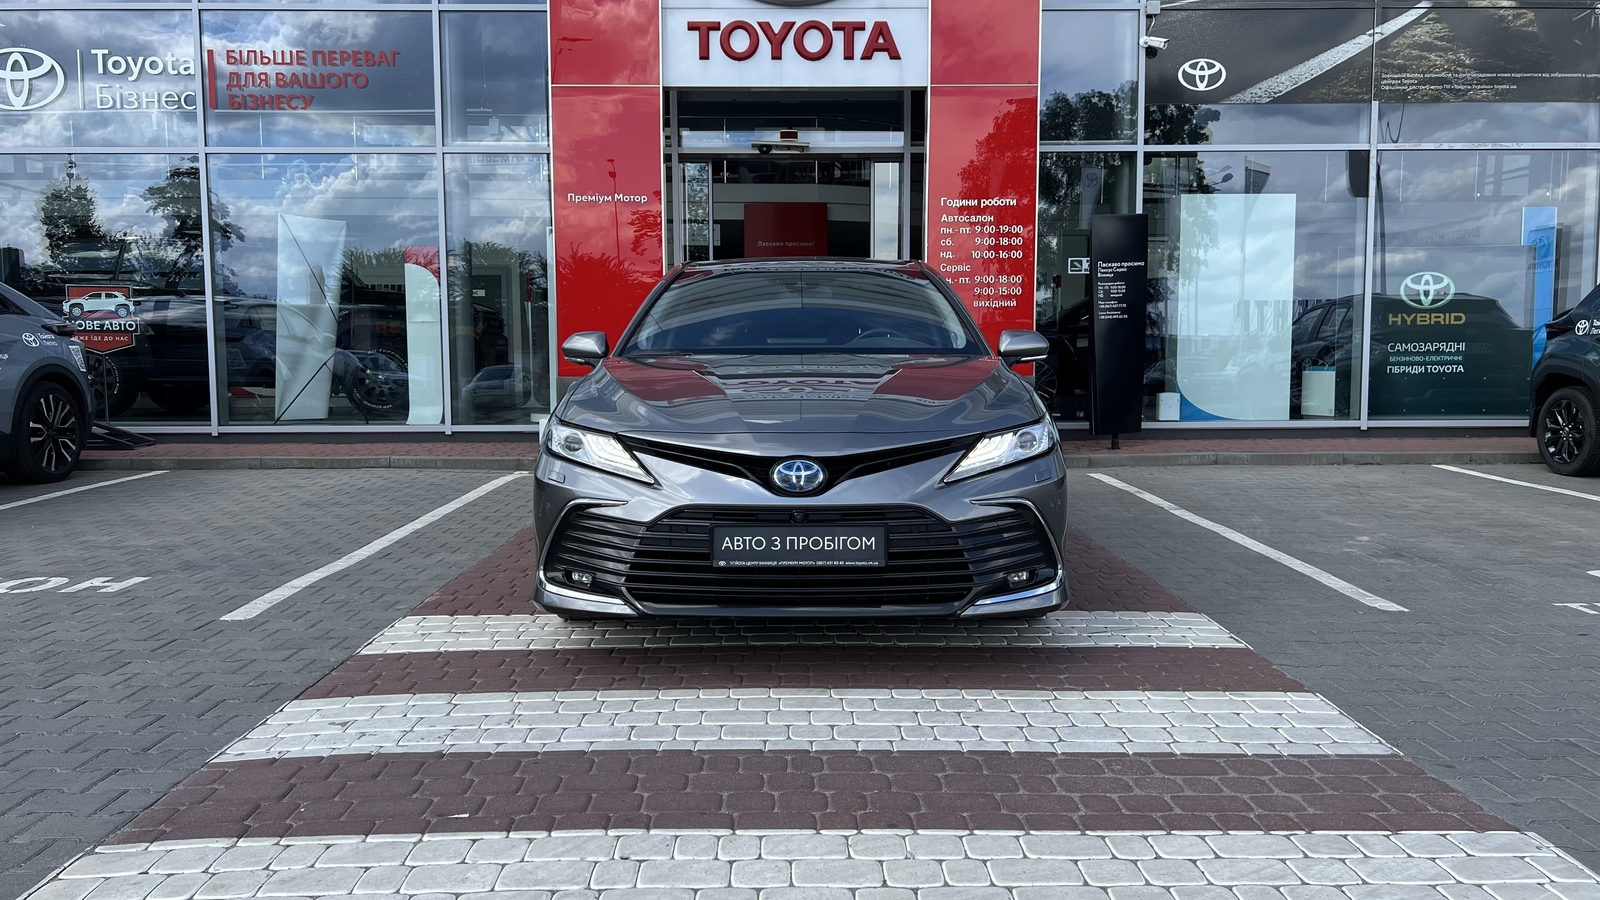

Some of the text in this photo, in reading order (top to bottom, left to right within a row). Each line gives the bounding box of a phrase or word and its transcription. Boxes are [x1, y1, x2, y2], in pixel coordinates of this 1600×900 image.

[687, 20, 902, 62] TOYOTA
[226, 50, 401, 67] БІЛЬШЕ ПЕРЕВАГ
[90, 48, 195, 81] Toyota
[226, 72, 370, 91] ДЛЯ ВАШОГО
[96, 84, 197, 110] Бізнес
[228, 94, 314, 110] БІЗНЕСУ
[568, 193, 648, 204] Преміум Мотор
[940, 196, 1017, 208] Години роботи
[941, 214, 994, 222] Автосалон
[975, 225, 1023, 234] 9:00-19:00
[975, 237, 1023, 246] 9:00-18:00
[972, 250, 1023, 259] 10:00-16:00
[940, 263, 971, 273] Сервіс
[974, 275, 1022, 284] 9:00-18:00
[974, 287, 1022, 295] 9:00-15:00
[973, 299, 1016, 308] вихідний
[1388, 313, 1466, 325] HYBRID
[104, 320, 136, 331] АВТО
[1388, 342, 1466, 352] САМОЗАРЯДНІ
[1386, 365, 1464, 374] ГІБРИДИ TOYOTA
[722, 536, 875, 550] АВТО З ПРОБІГОМ
